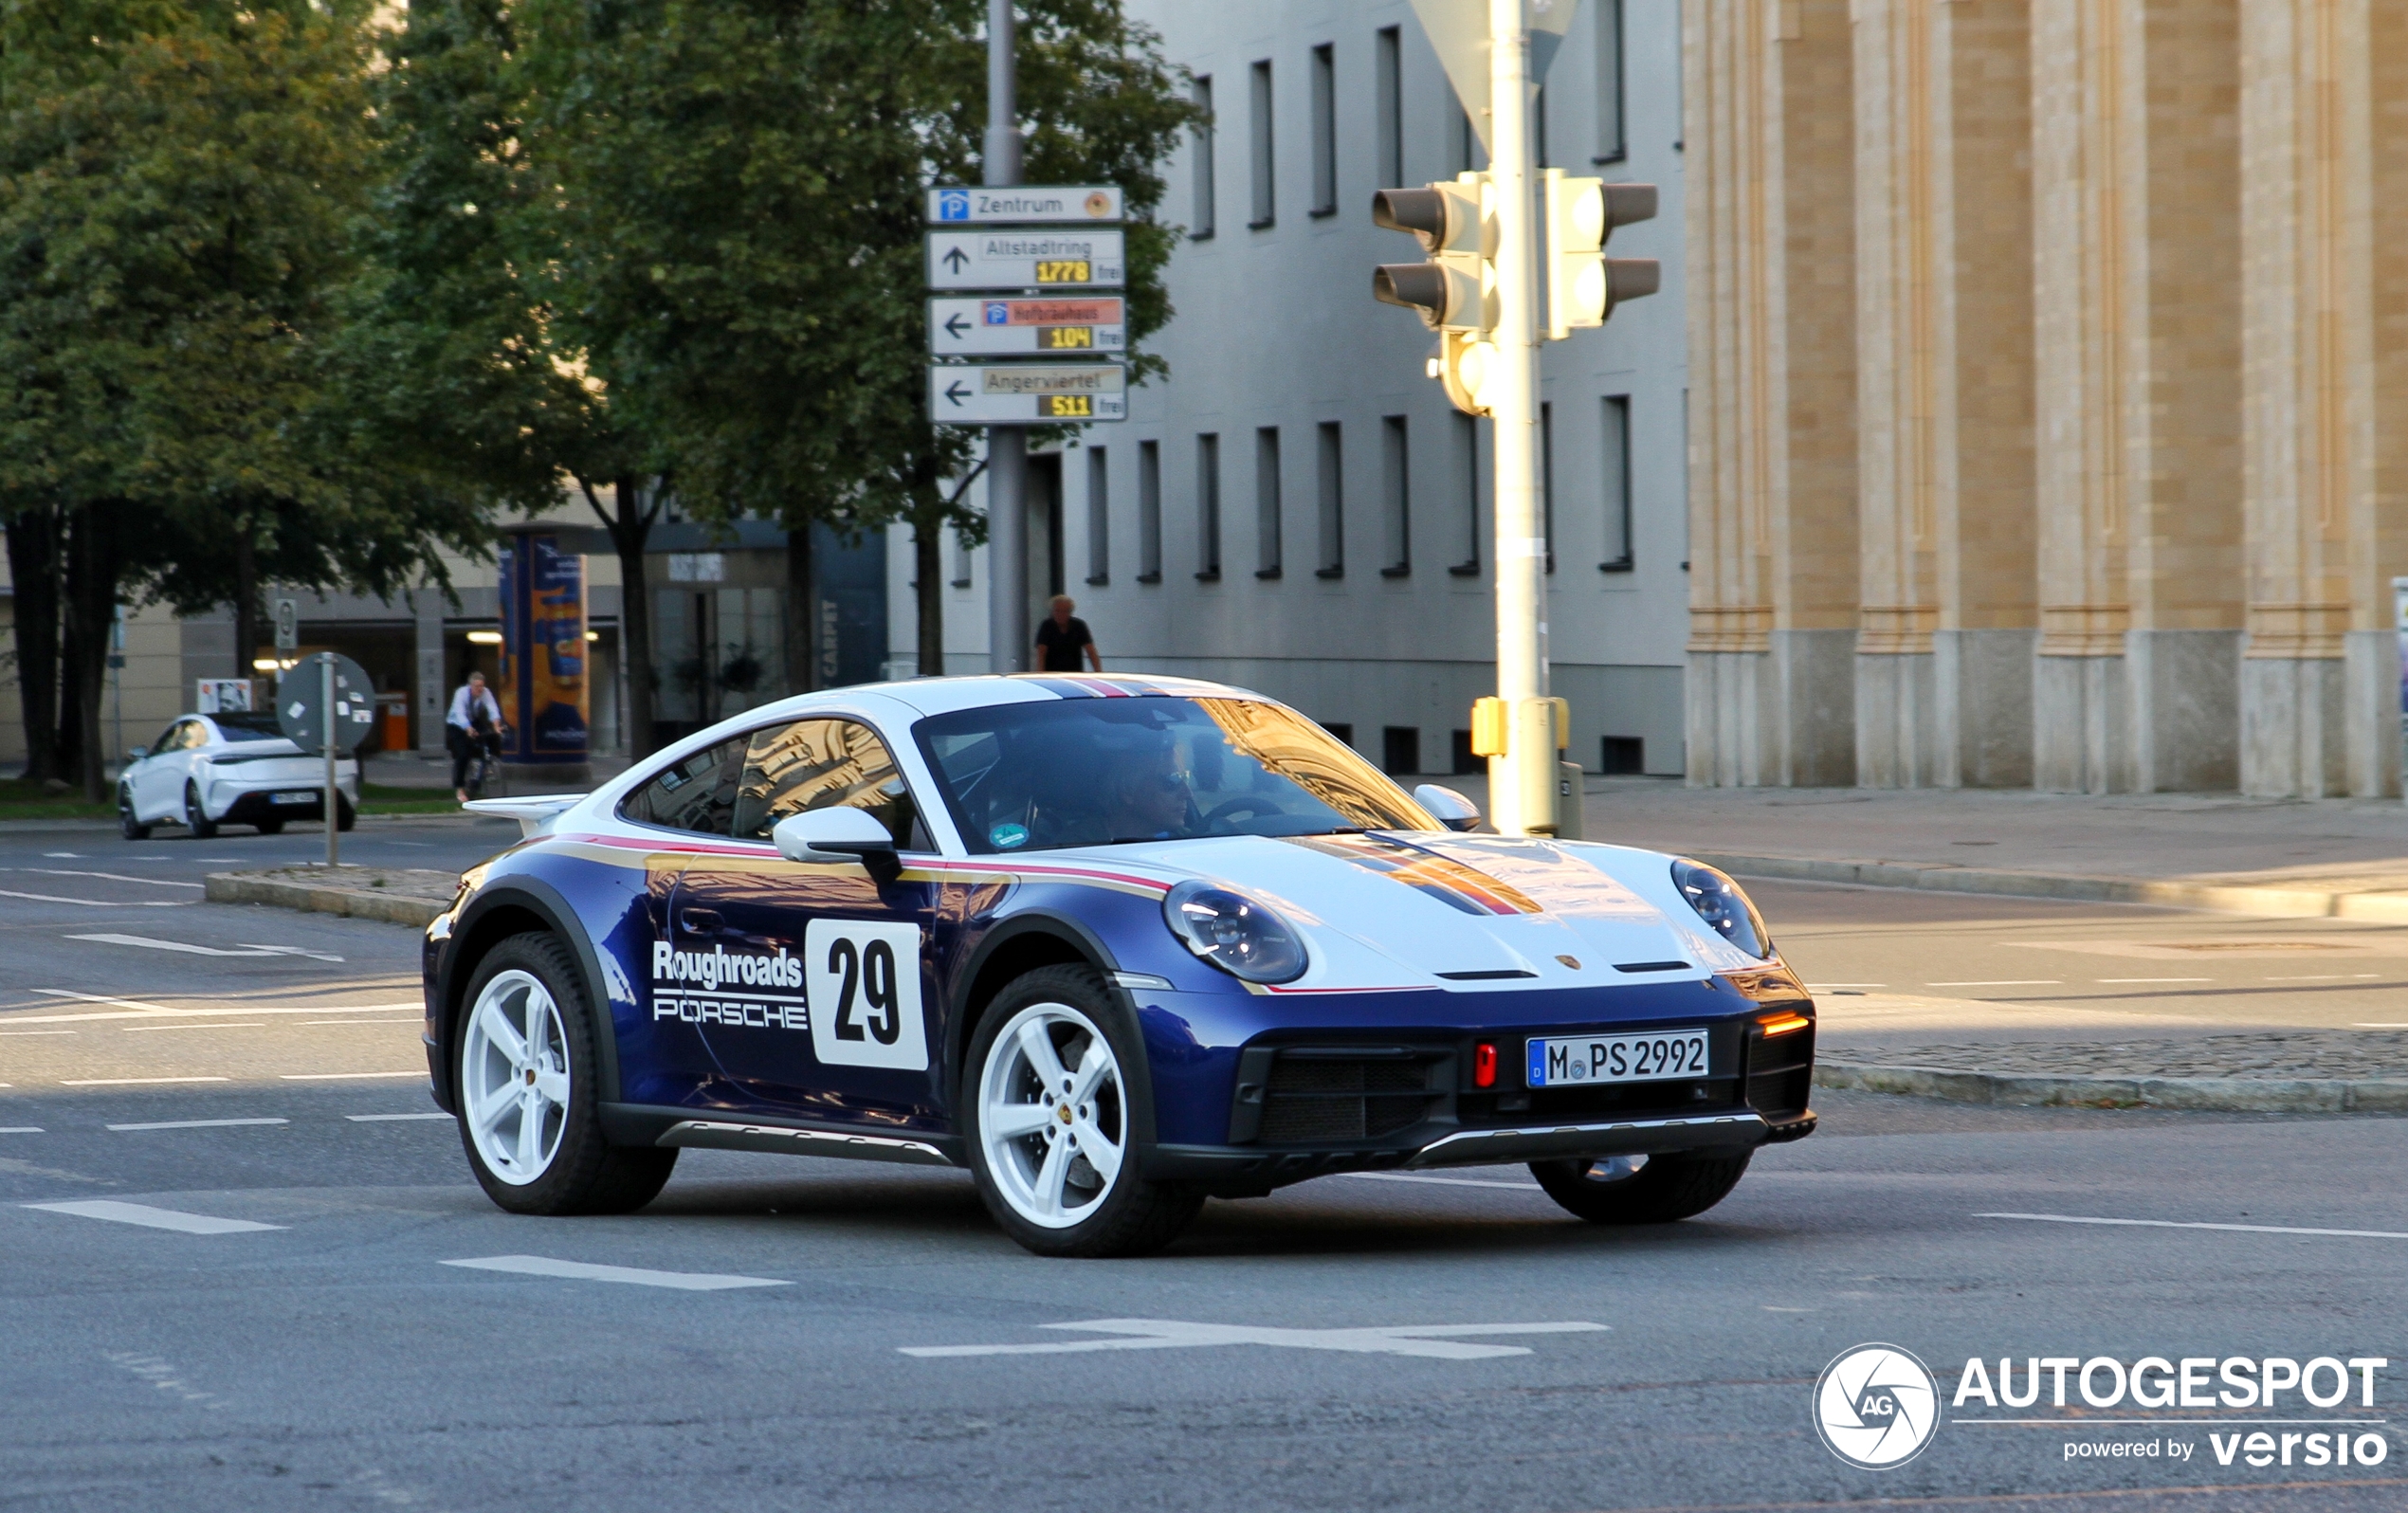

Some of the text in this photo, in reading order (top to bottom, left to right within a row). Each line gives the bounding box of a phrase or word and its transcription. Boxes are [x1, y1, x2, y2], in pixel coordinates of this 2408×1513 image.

[977, 195, 1064, 213] Zentrum
[986, 239, 1091, 259] Altstadtring
[1036, 261, 1121, 283] 1778 frei
[1050, 327, 1090, 348] 104
[986, 373, 1102, 392] Angerviertel
[1050, 395, 1090, 416] 511
[652, 939, 804, 991] Roughroads
[828, 937, 901, 1046] 29
[653, 998, 809, 1030] PORSCHE
[1548, 1045, 1568, 1080] M
